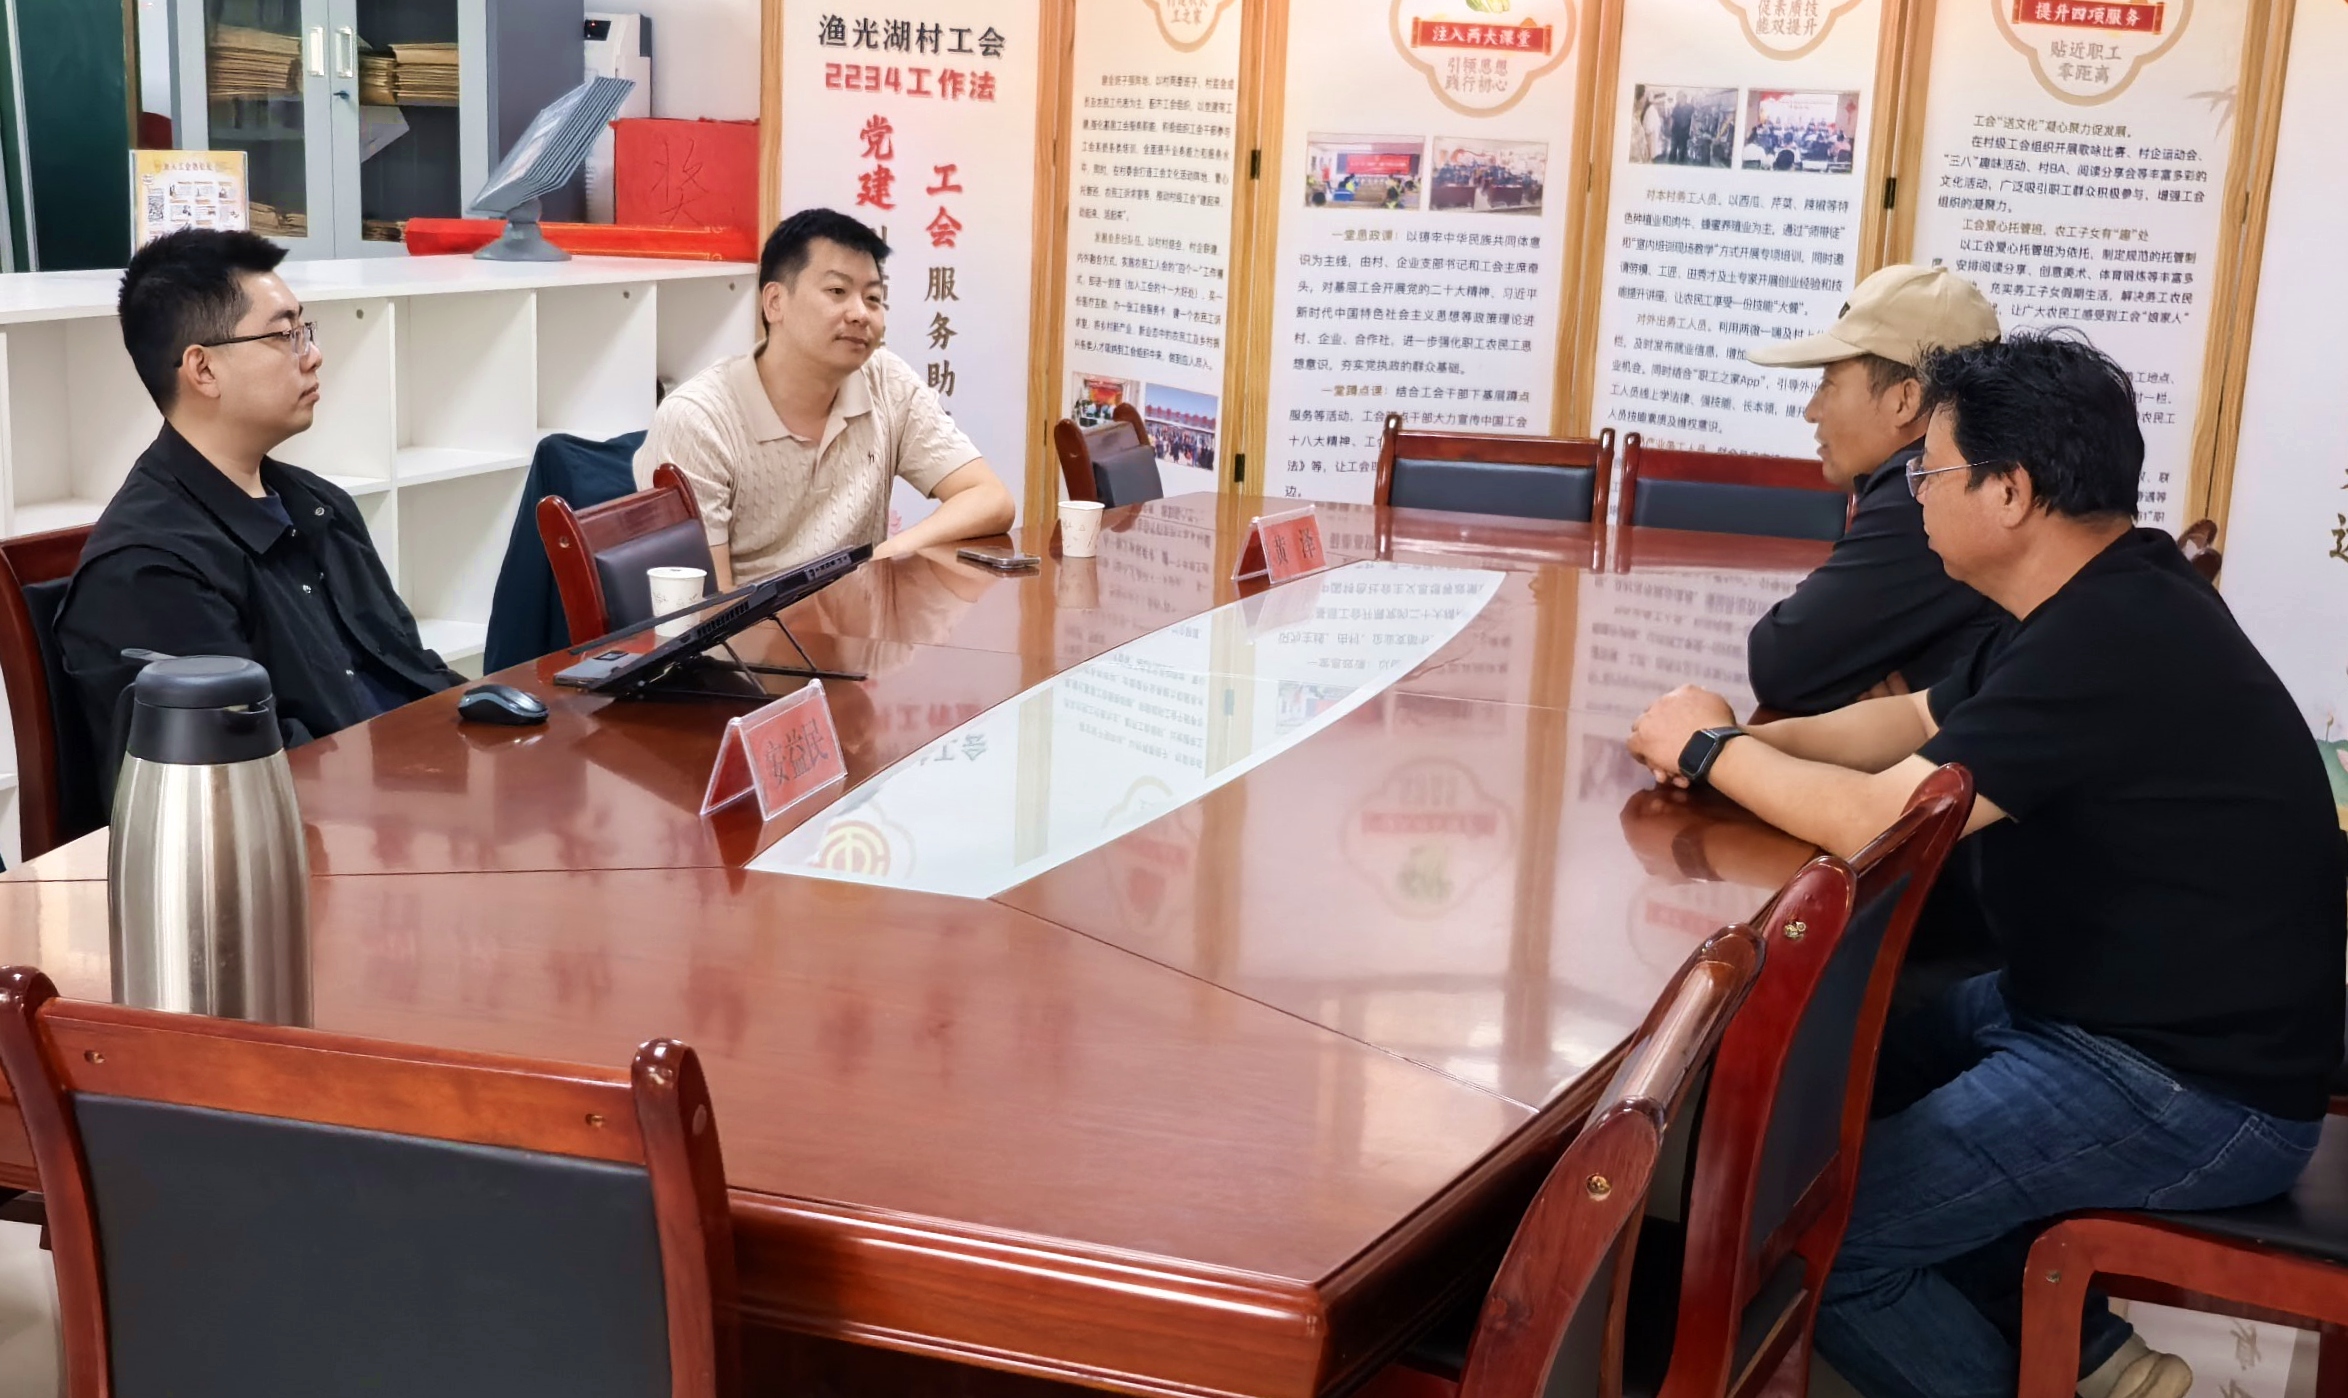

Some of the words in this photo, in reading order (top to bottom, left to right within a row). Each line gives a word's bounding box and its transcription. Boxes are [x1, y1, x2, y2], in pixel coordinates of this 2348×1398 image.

[2035, 2, 2142, 28] 提升四项服务
[819, 14, 1006, 57] 渔光湖村工会
[1432, 25, 1531, 48] 注入两大课堂
[1756, 17, 1818, 36] 能双提升
[2050, 40, 2122, 62] 贴近职工
[1447, 57, 1508, 76] 引领思想
[2057, 62, 2111, 84] 零距离
[825, 62, 996, 101] 2234工作法
[1445, 75, 1508, 93] 践行初心
[856, 114, 896, 211] 党建
[924, 164, 963, 397] 工会服务助
[2137, 412, 2176, 424] 农民工
[1288, 434, 1384, 449] 十八大精神、工
[766, 717, 829, 787] 安益民
